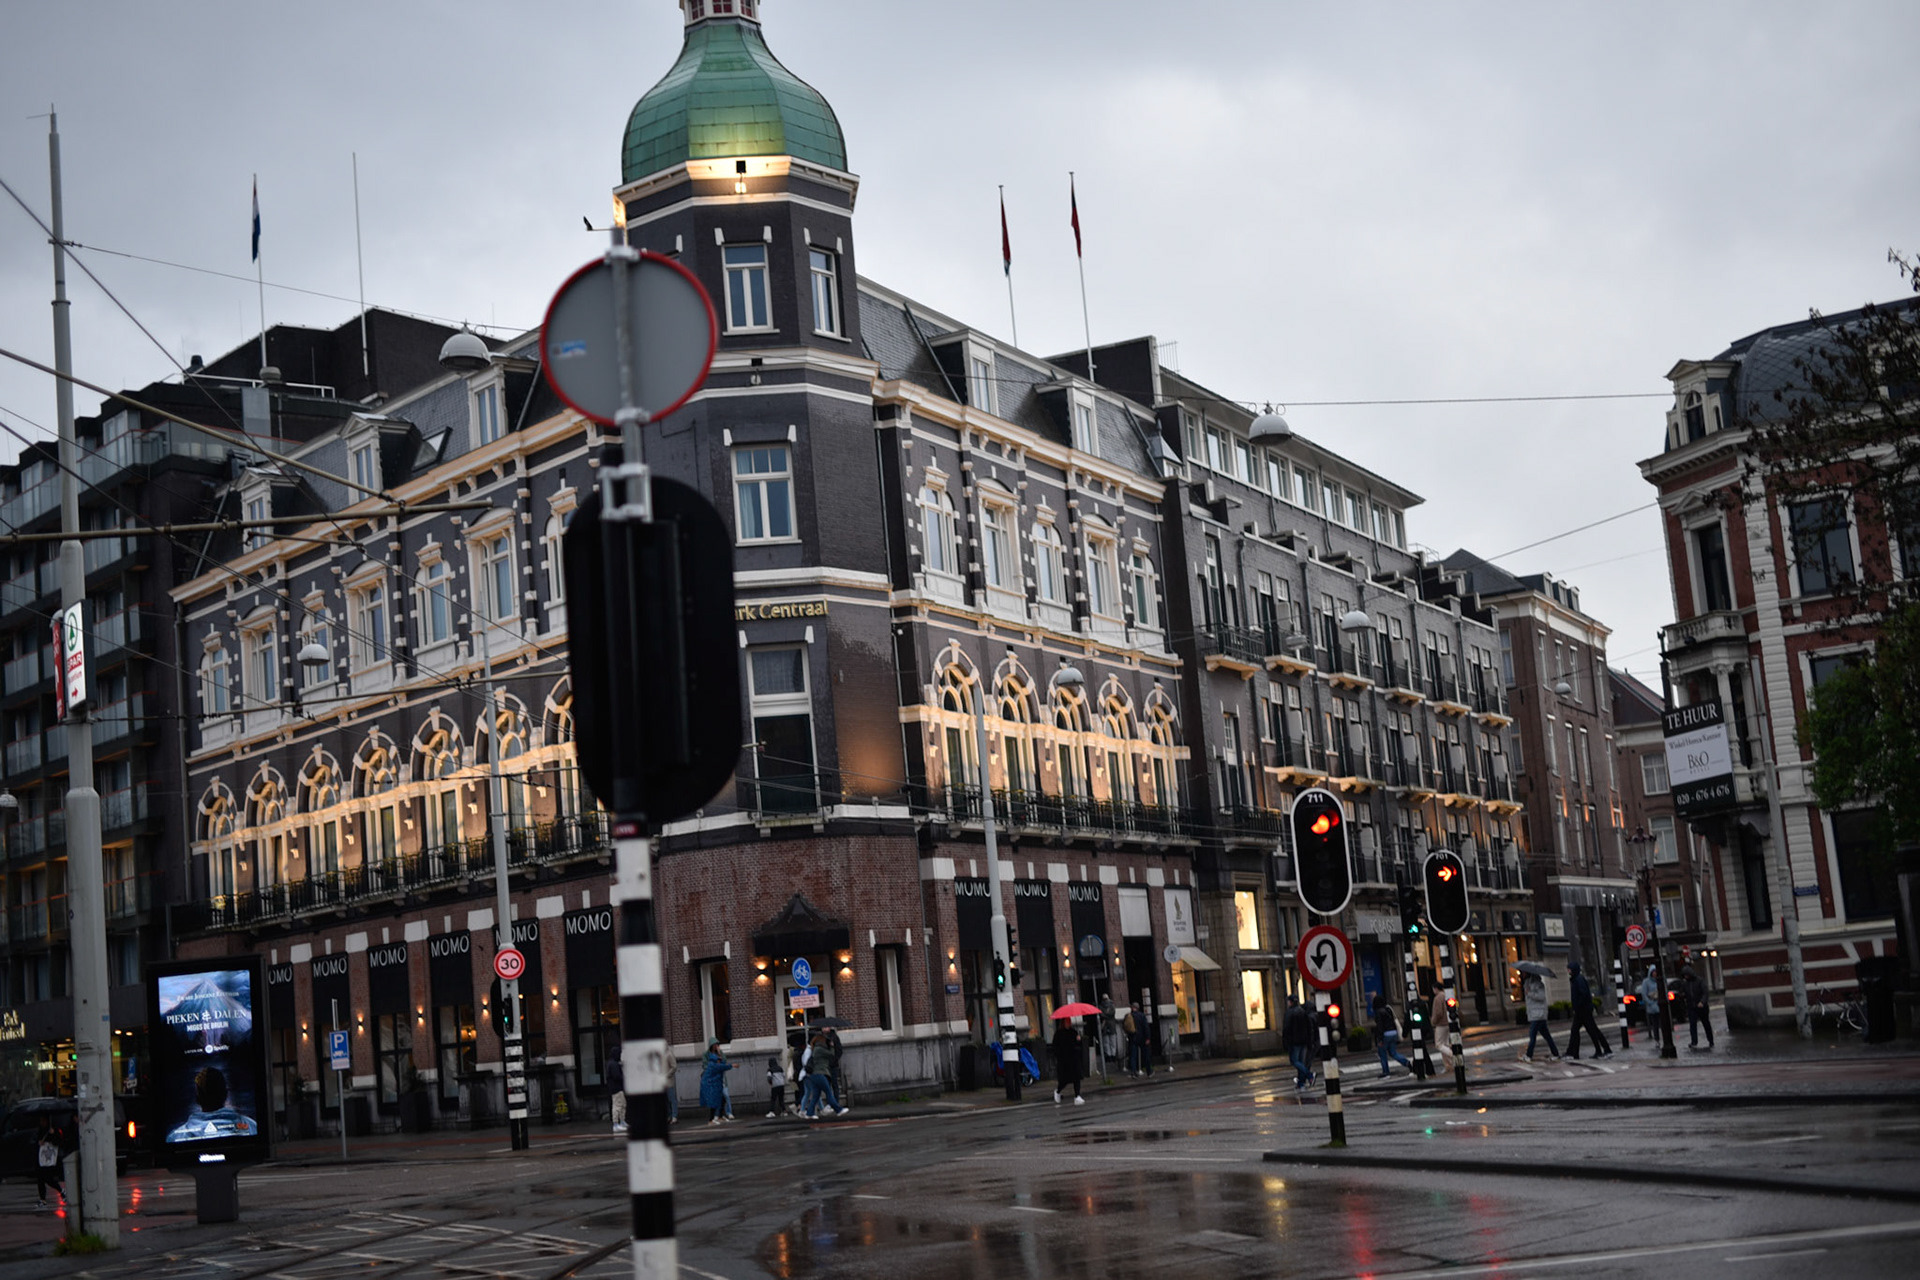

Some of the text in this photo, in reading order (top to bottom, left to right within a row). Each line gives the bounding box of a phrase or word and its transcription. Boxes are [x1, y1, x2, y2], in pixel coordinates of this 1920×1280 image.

[760, 599, 829, 619] Centraal
[1666, 703, 1718, 730] TE HUUR
[1688, 751, 1709, 769] B&O
[1307, 793, 1324, 803] 711
[1677, 793, 1690, 805] 020
[954, 881, 991, 898] MOMO
[1014, 883, 1048, 898] MOMO
[1068, 885, 1100, 903] MOMO
[566, 911, 612, 935] MOMO
[430, 934, 470, 958] MOMO
[1628, 932, 1643, 943] 30
[369, 946, 407, 968] MOMO
[500, 958, 520, 971] 30
[313, 957, 347, 978] MOMO
[268, 968, 293, 985] OMO
[166, 1012, 200, 1025] PIEKEN
[214, 1009, 246, 1020] DALEN
[333, 1033, 345, 1049] P
